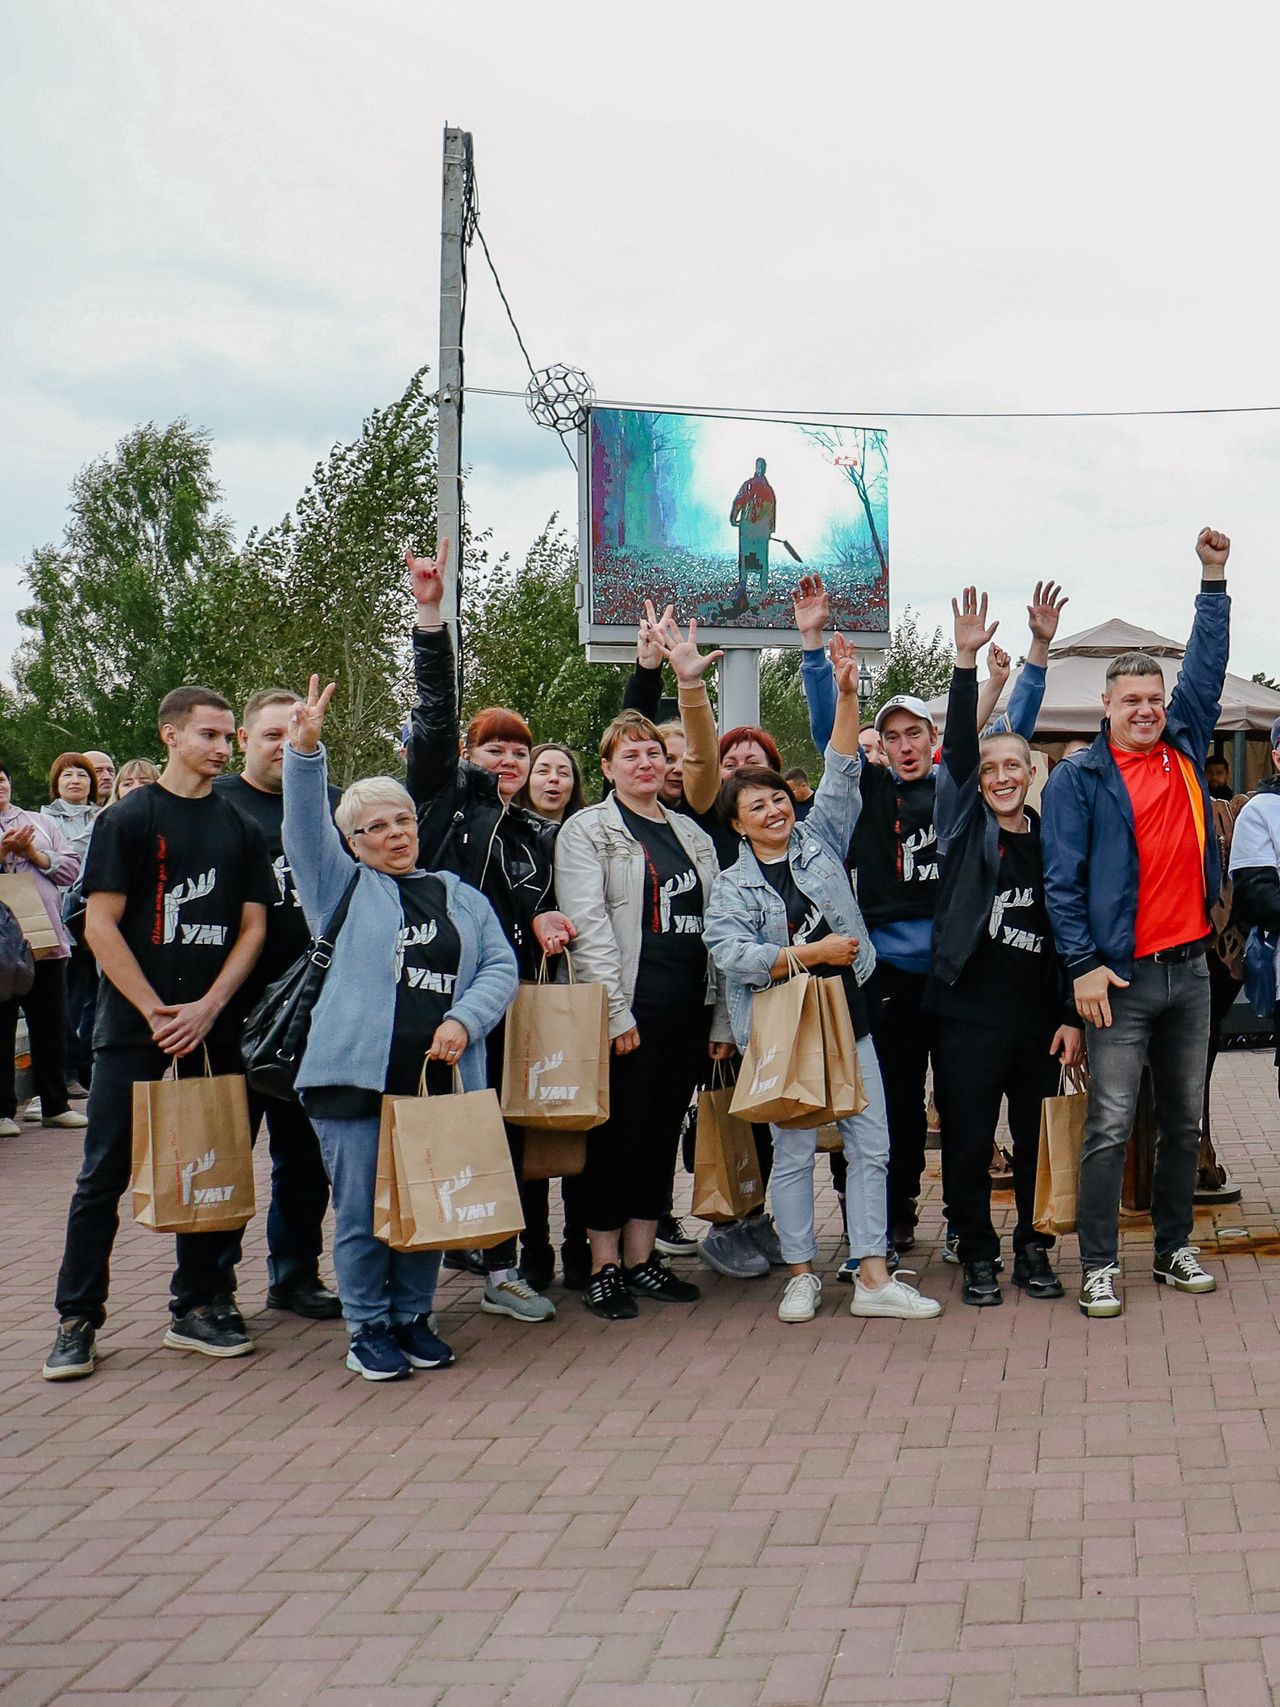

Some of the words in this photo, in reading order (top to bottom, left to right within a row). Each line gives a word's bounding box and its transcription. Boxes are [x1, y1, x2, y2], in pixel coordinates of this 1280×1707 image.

[406, 966, 458, 994] УМТ
[539, 1086, 580, 1100] УМТ
[193, 1185, 235, 1205] УМТ
[455, 1201, 498, 1222] УМТ
